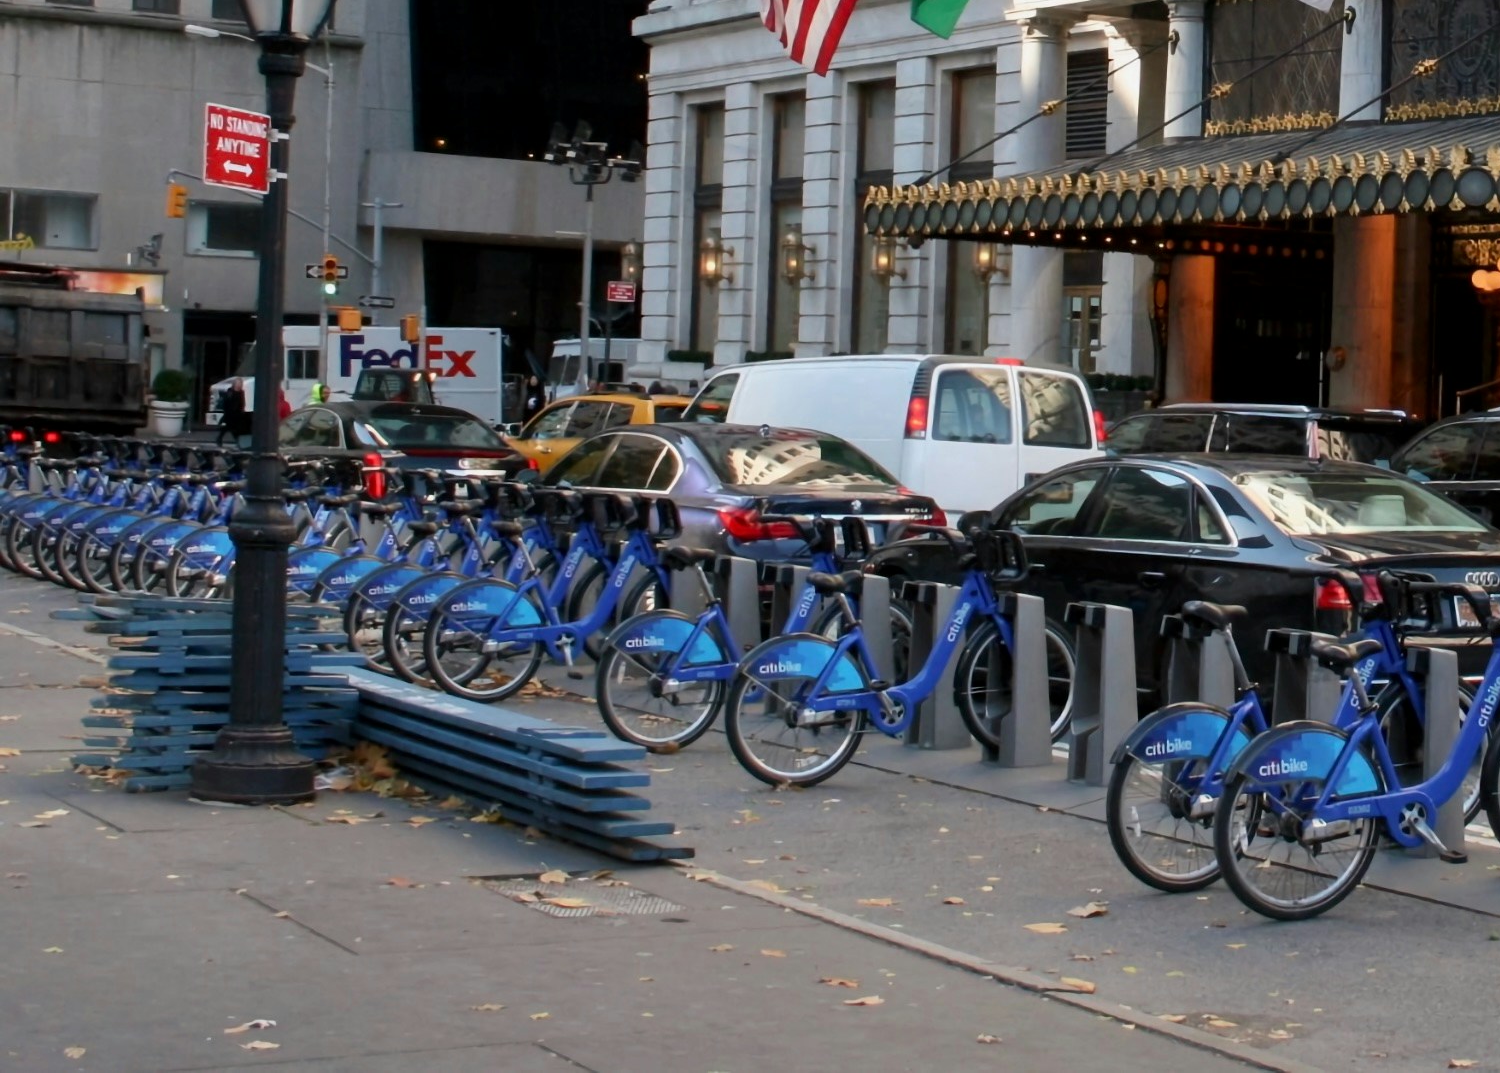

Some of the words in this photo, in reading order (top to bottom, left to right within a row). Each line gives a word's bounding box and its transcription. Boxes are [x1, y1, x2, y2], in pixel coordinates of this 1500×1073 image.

[210, 113, 224, 130] NO
[226, 116, 268, 139] STANDING
[216, 136, 261, 158] ANYTIME
[340, 335, 477, 377] FedEx
[625, 637, 642, 648] citi
[643, 635, 665, 647] bike
[759, 662, 777, 674] citi
[779, 660, 802, 673] bike
[1478, 703, 1493, 727] citi
[1145, 741, 1166, 757] citi
[1166, 738, 1193, 754] bike
[1259, 762, 1280, 778] citi
[1281, 756, 1308, 773] bike
